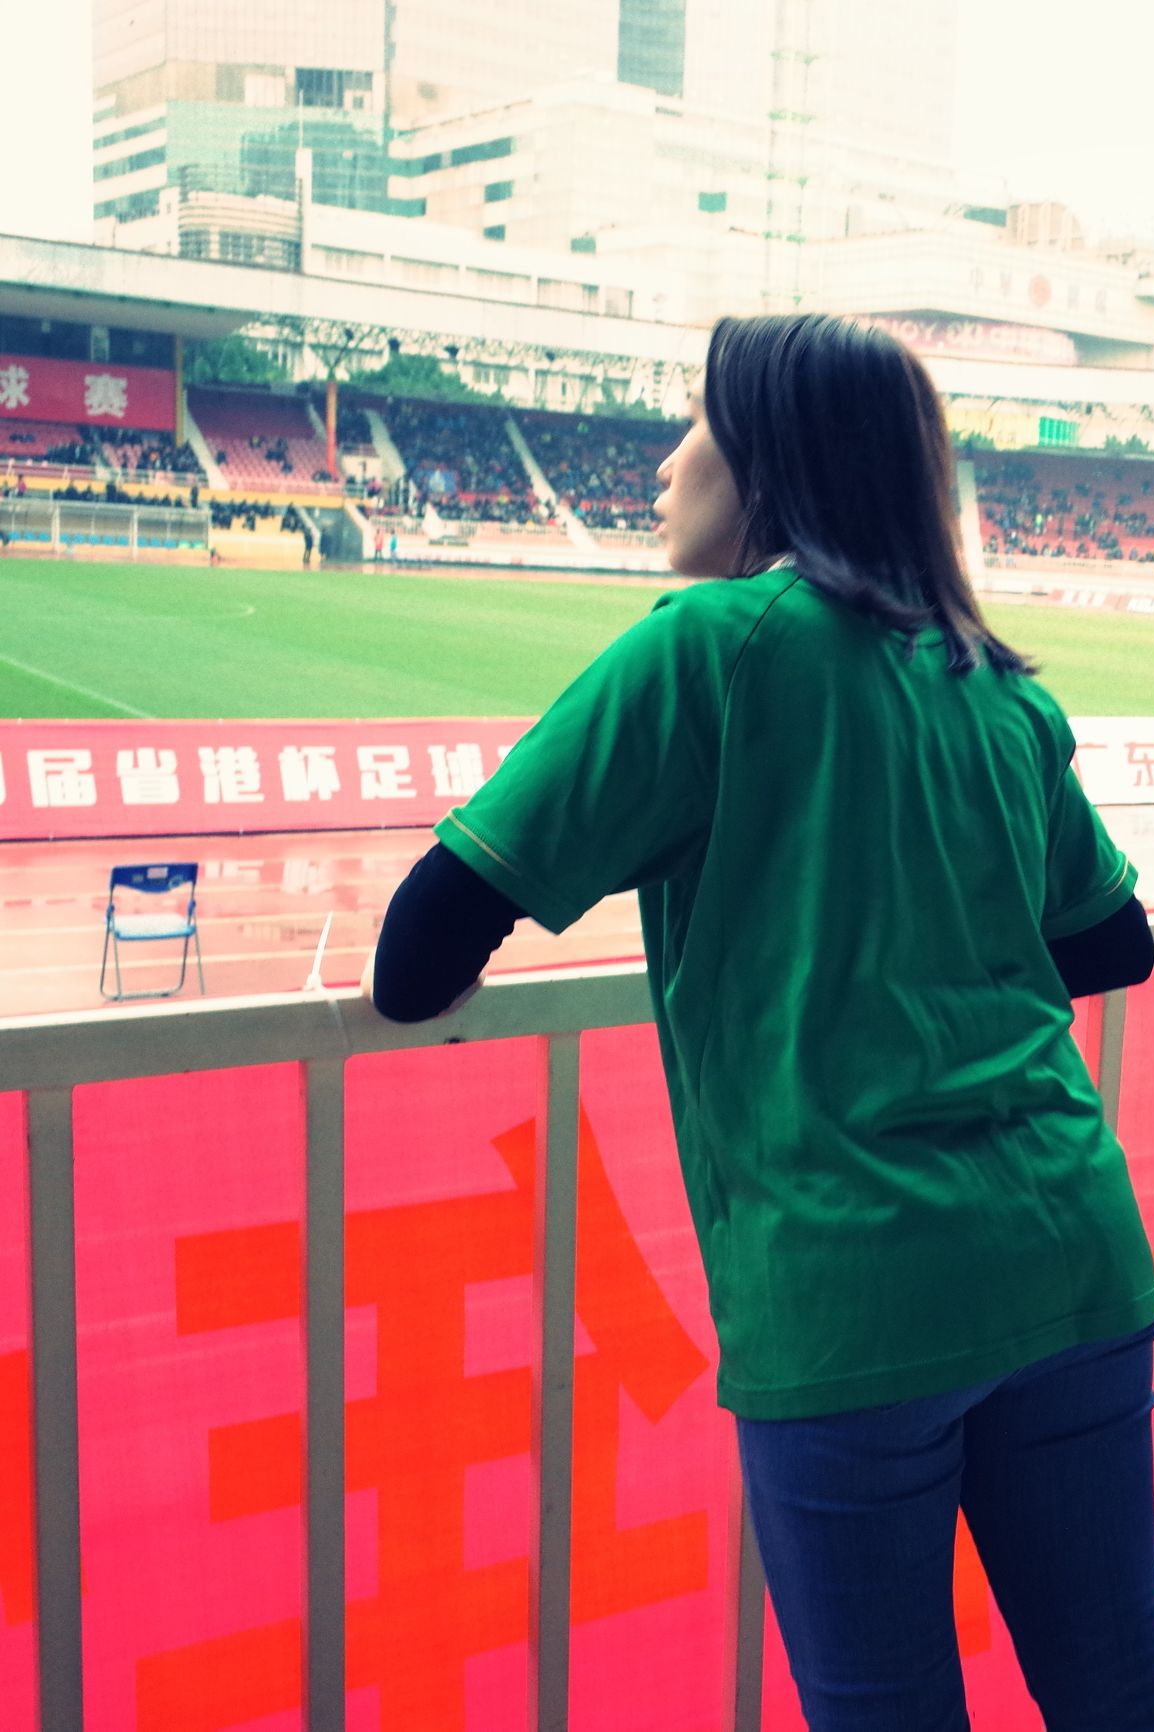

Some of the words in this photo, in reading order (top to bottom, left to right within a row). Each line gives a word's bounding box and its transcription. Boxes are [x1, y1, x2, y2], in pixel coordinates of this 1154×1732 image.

[0, 743, 514, 808] 届省港杯足球
